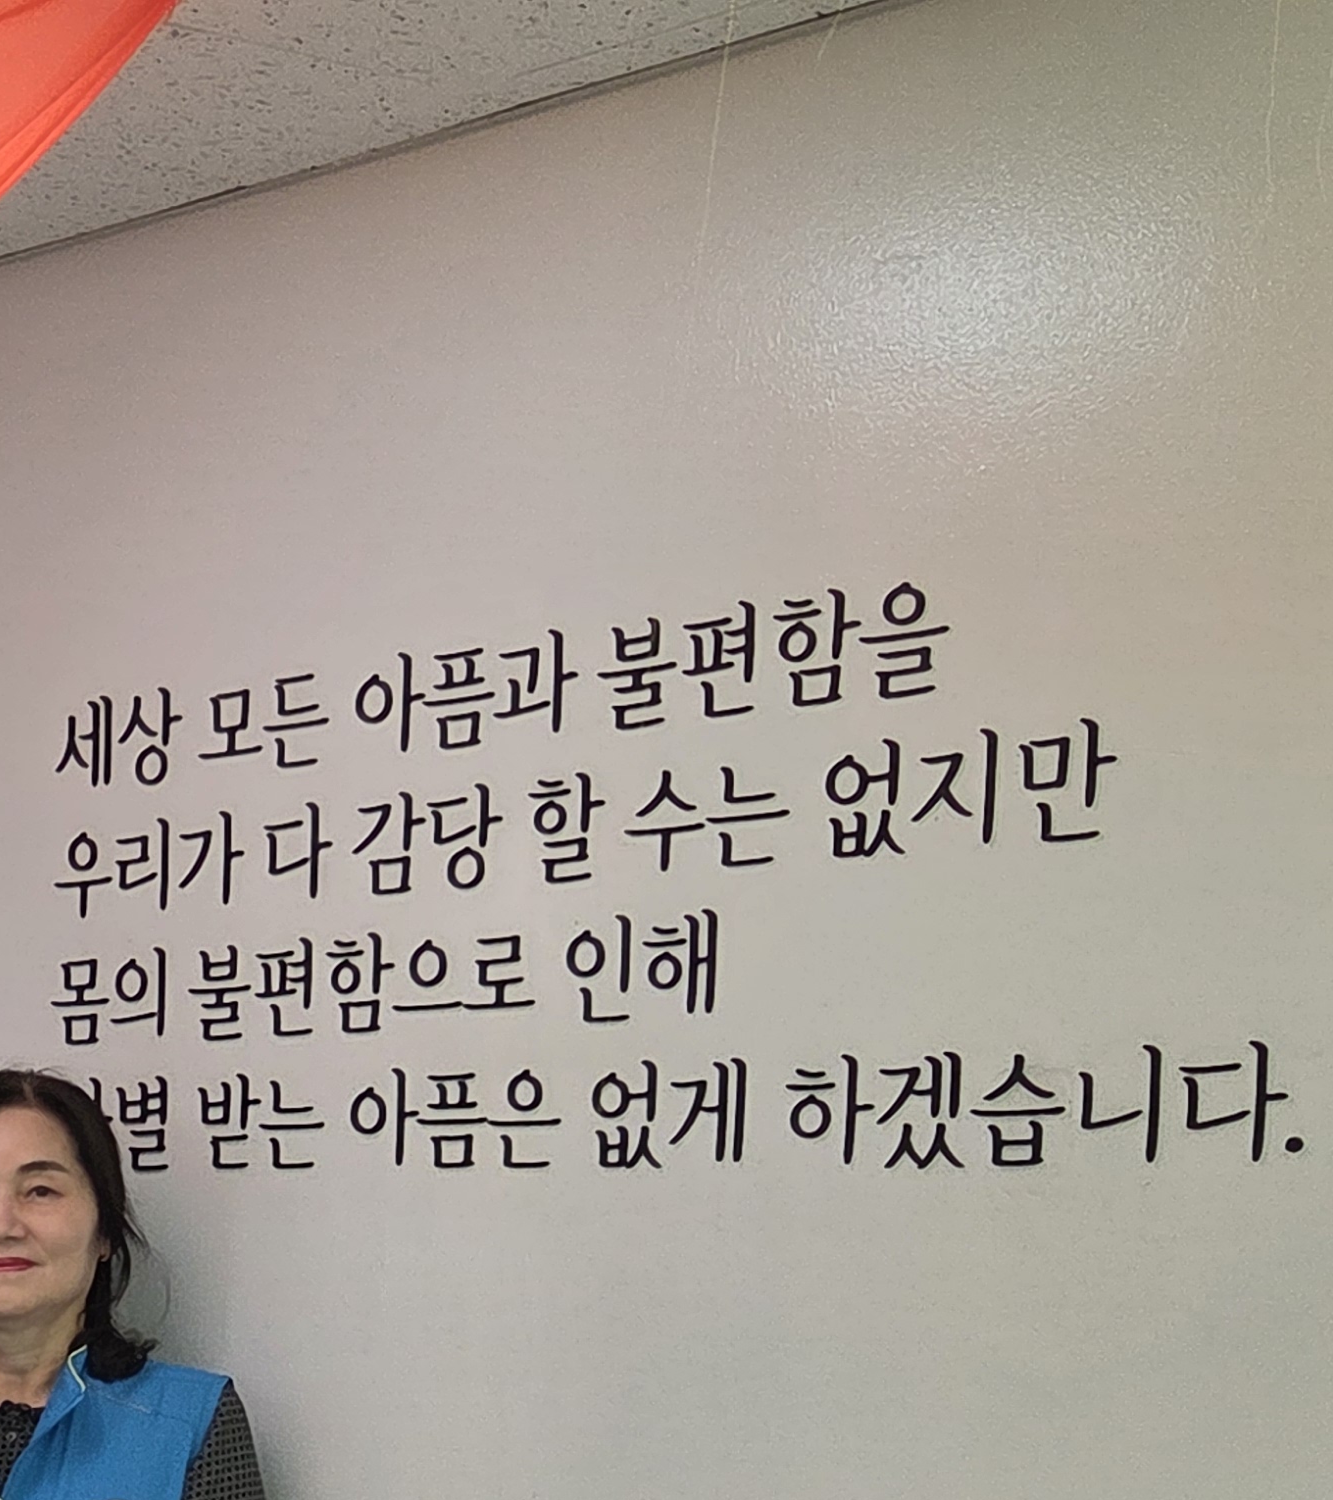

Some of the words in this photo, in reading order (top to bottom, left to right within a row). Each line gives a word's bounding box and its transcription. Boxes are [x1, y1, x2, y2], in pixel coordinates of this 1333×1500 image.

[56, 688, 182, 787] 세상
[199, 674, 329, 768] 모든
[356, 629, 578, 752] 아픔과
[598, 582, 949, 730] 불편함을
[54, 811, 244, 918] 우리가
[264, 803, 332, 898] 다
[352, 784, 503, 895] 감당
[529, 773, 605, 883] 할
[625, 767, 790, 871] 수는
[826, 718, 1117, 858] 없지만
[51, 947, 165, 1045] 몸의
[188, 933, 535, 1041] 불편함으로
[567, 909, 717, 1023] 인해
[89, 1075, 169, 1172] 별
[198, 1074, 324, 1169] 받는
[351, 1068, 561, 1168] 아픔은
[592, 1058, 746, 1168] 없게
[786, 1041, 1303, 1169] 하겠습니다.
